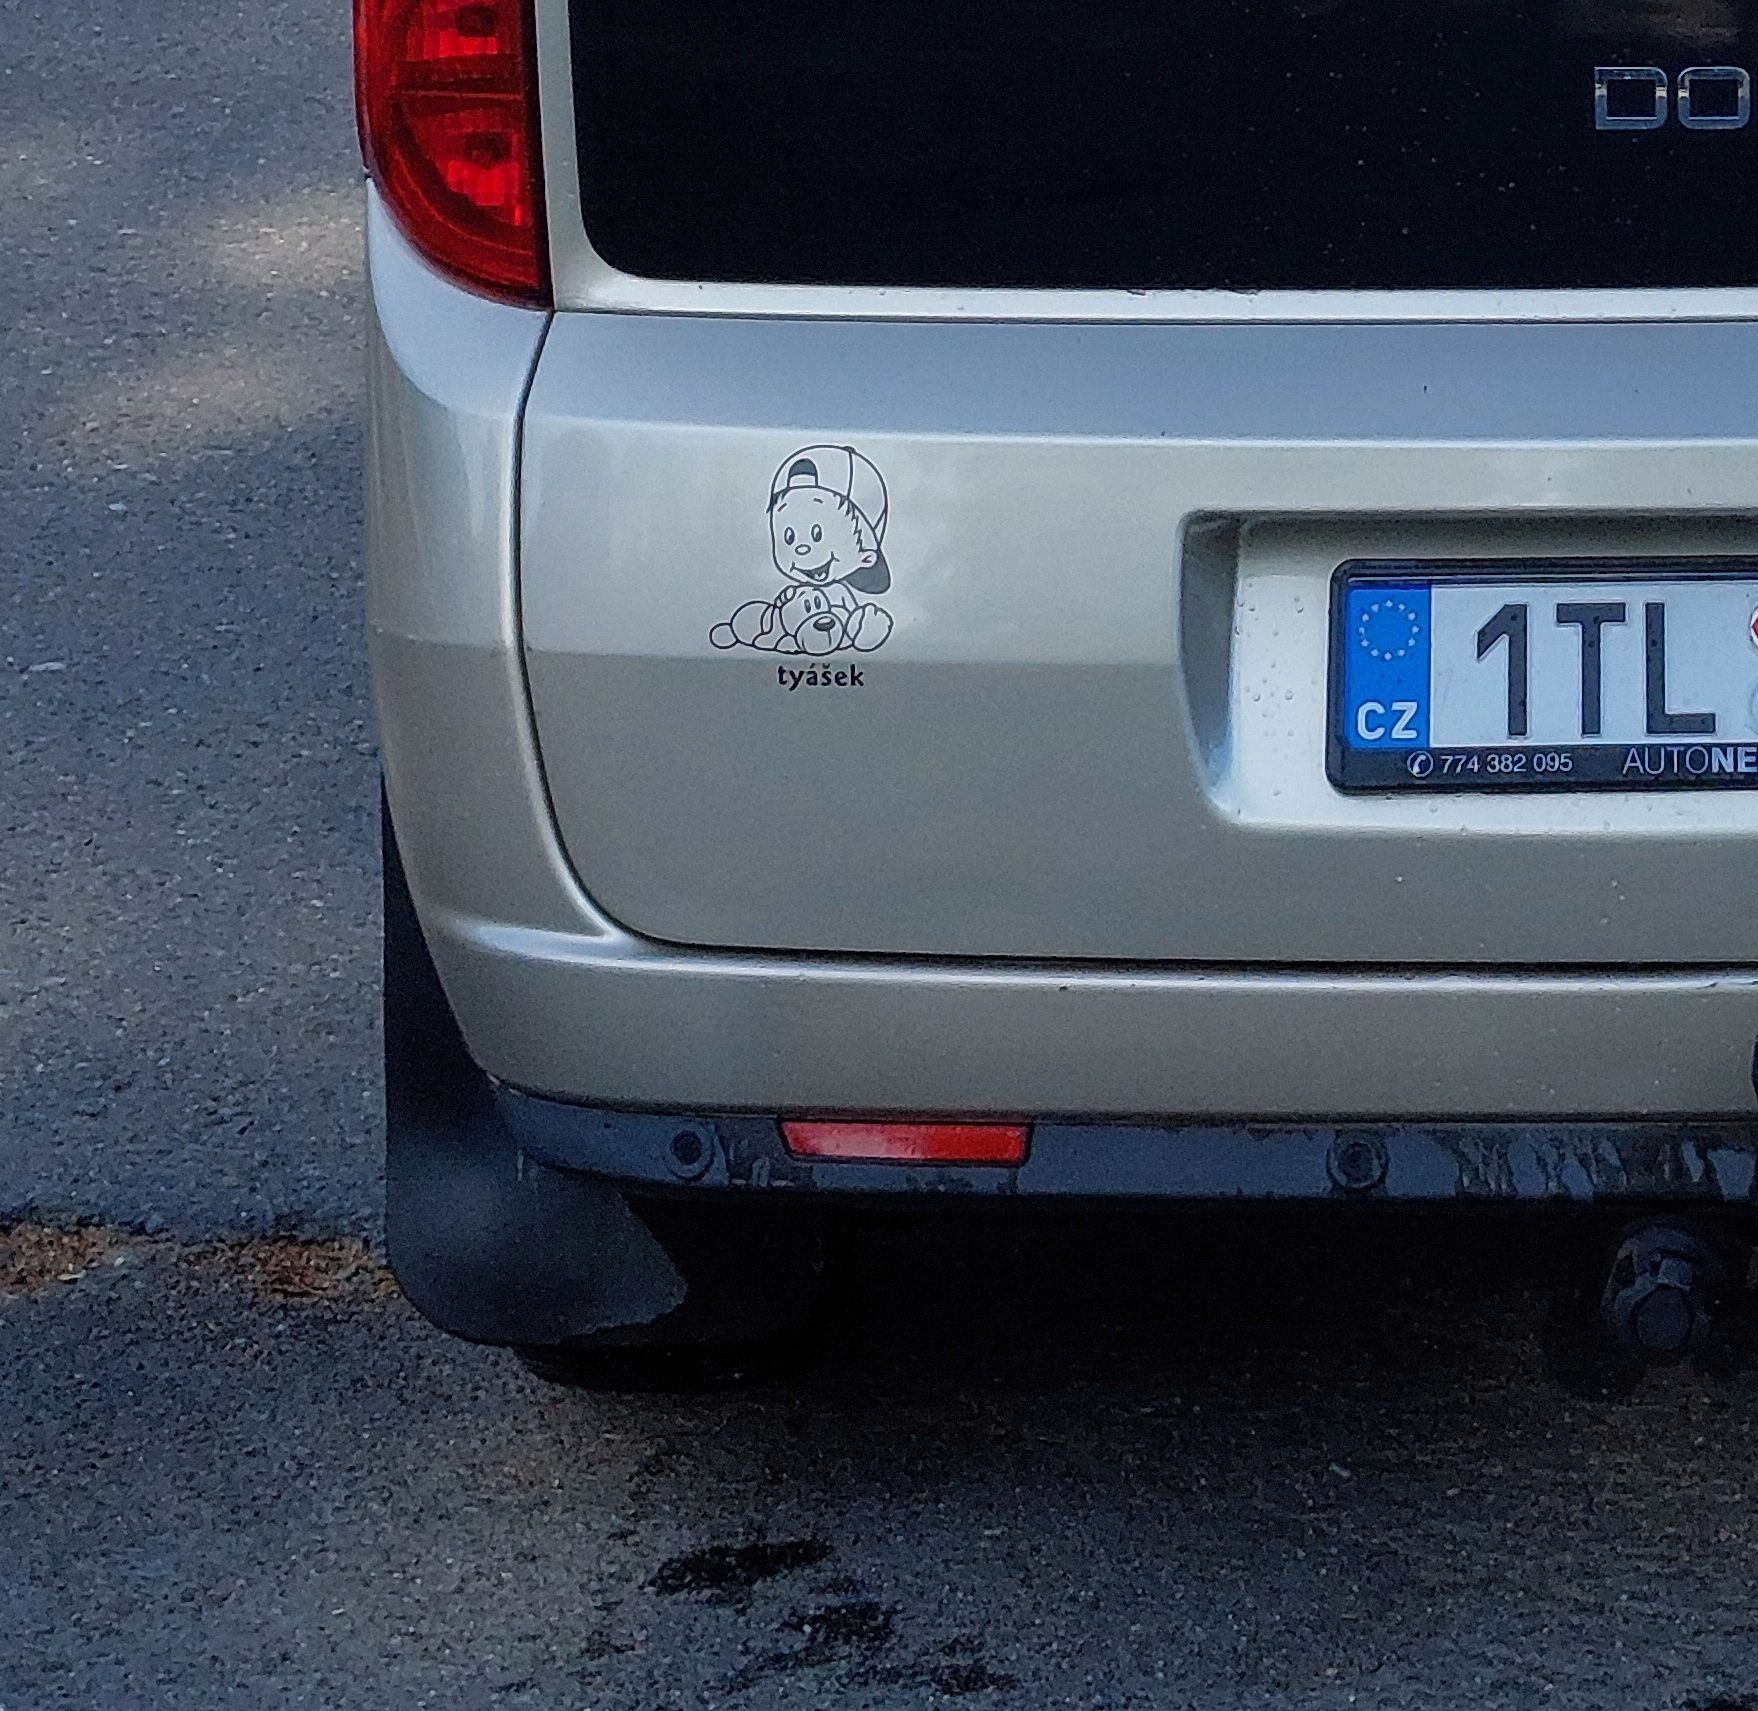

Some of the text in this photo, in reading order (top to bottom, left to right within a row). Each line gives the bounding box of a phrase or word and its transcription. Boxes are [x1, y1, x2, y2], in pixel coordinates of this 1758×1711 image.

[776, 662, 865, 692] tyášek
[1476, 602, 1717, 737] 1TL
[1356, 701, 1419, 740] CZ
[1440, 753, 1574, 774] 774 382 095
